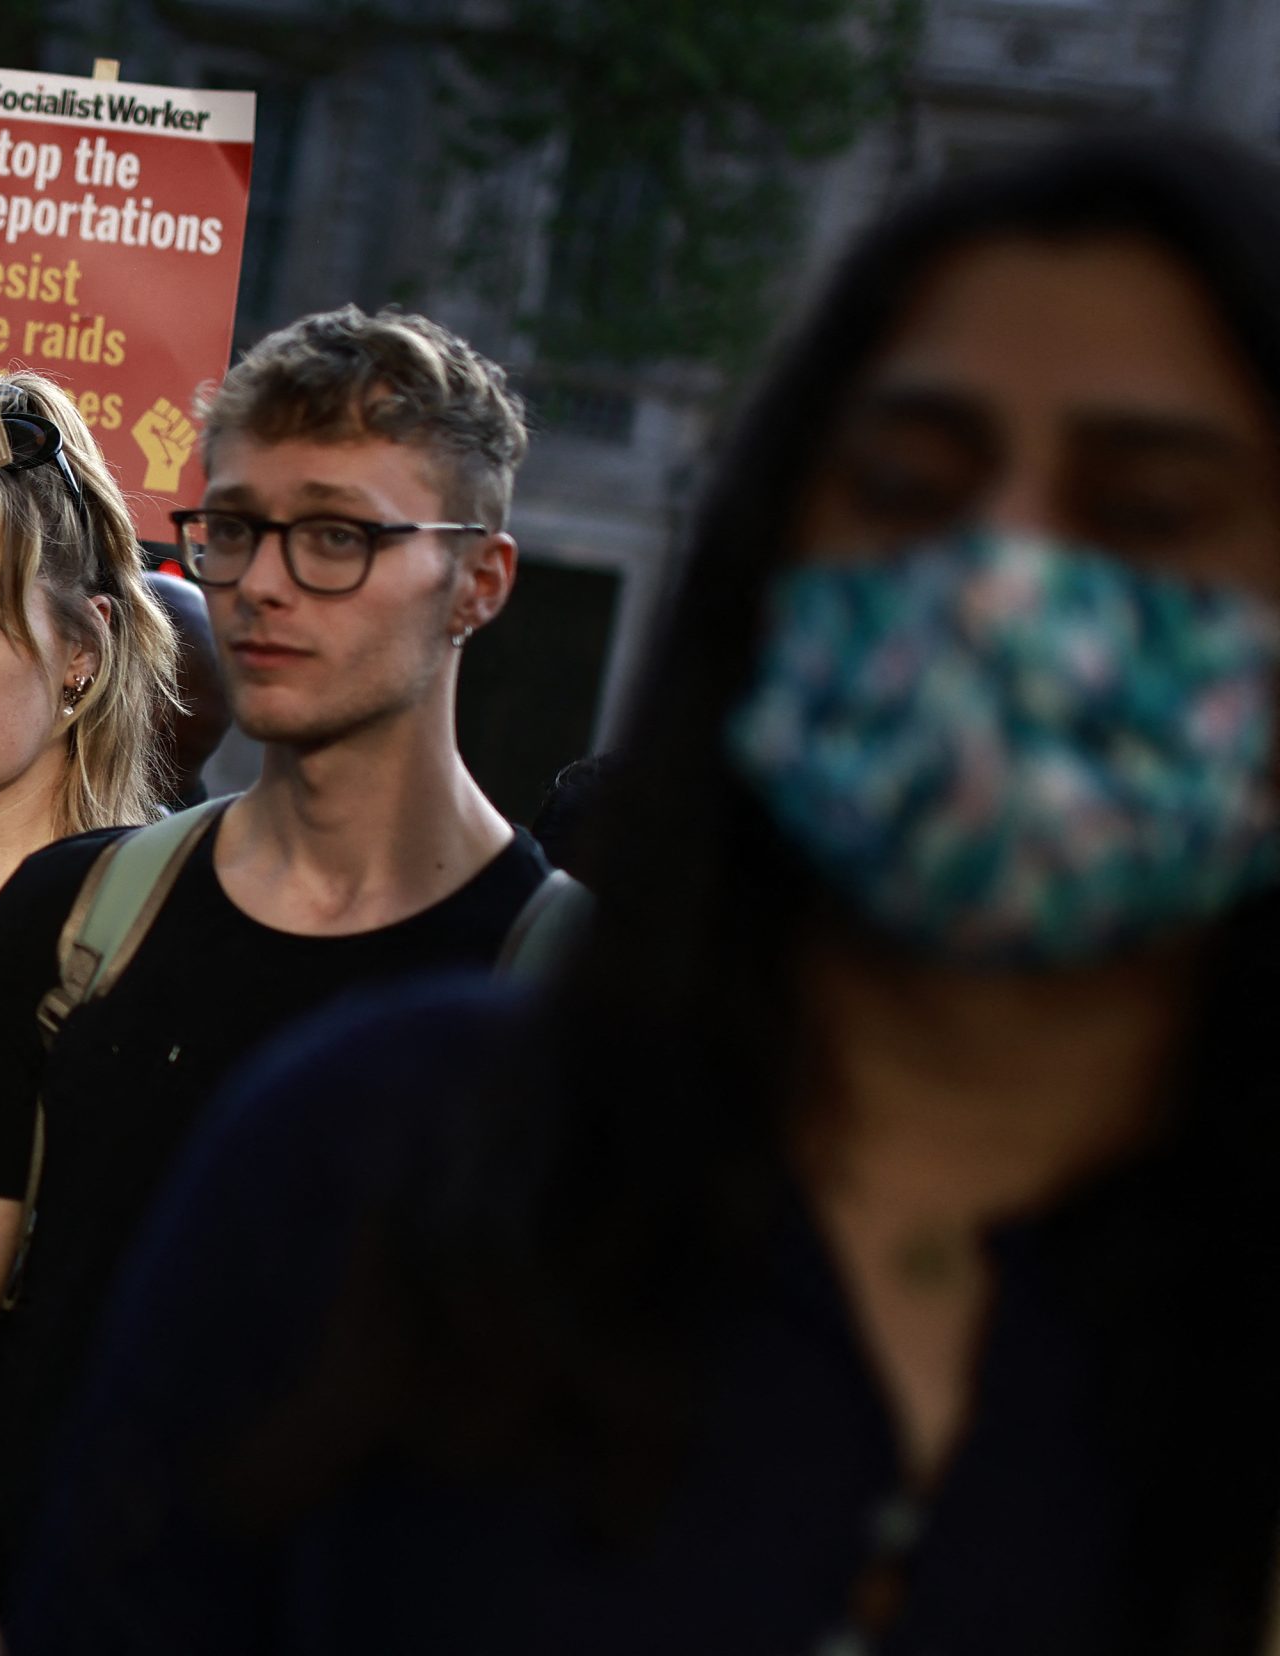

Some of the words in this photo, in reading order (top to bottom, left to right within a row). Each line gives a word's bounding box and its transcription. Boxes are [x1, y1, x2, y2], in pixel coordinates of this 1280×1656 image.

[107, 94, 210, 131] Worker
[74, 136, 140, 189] the
[23, 312, 126, 367] raids
